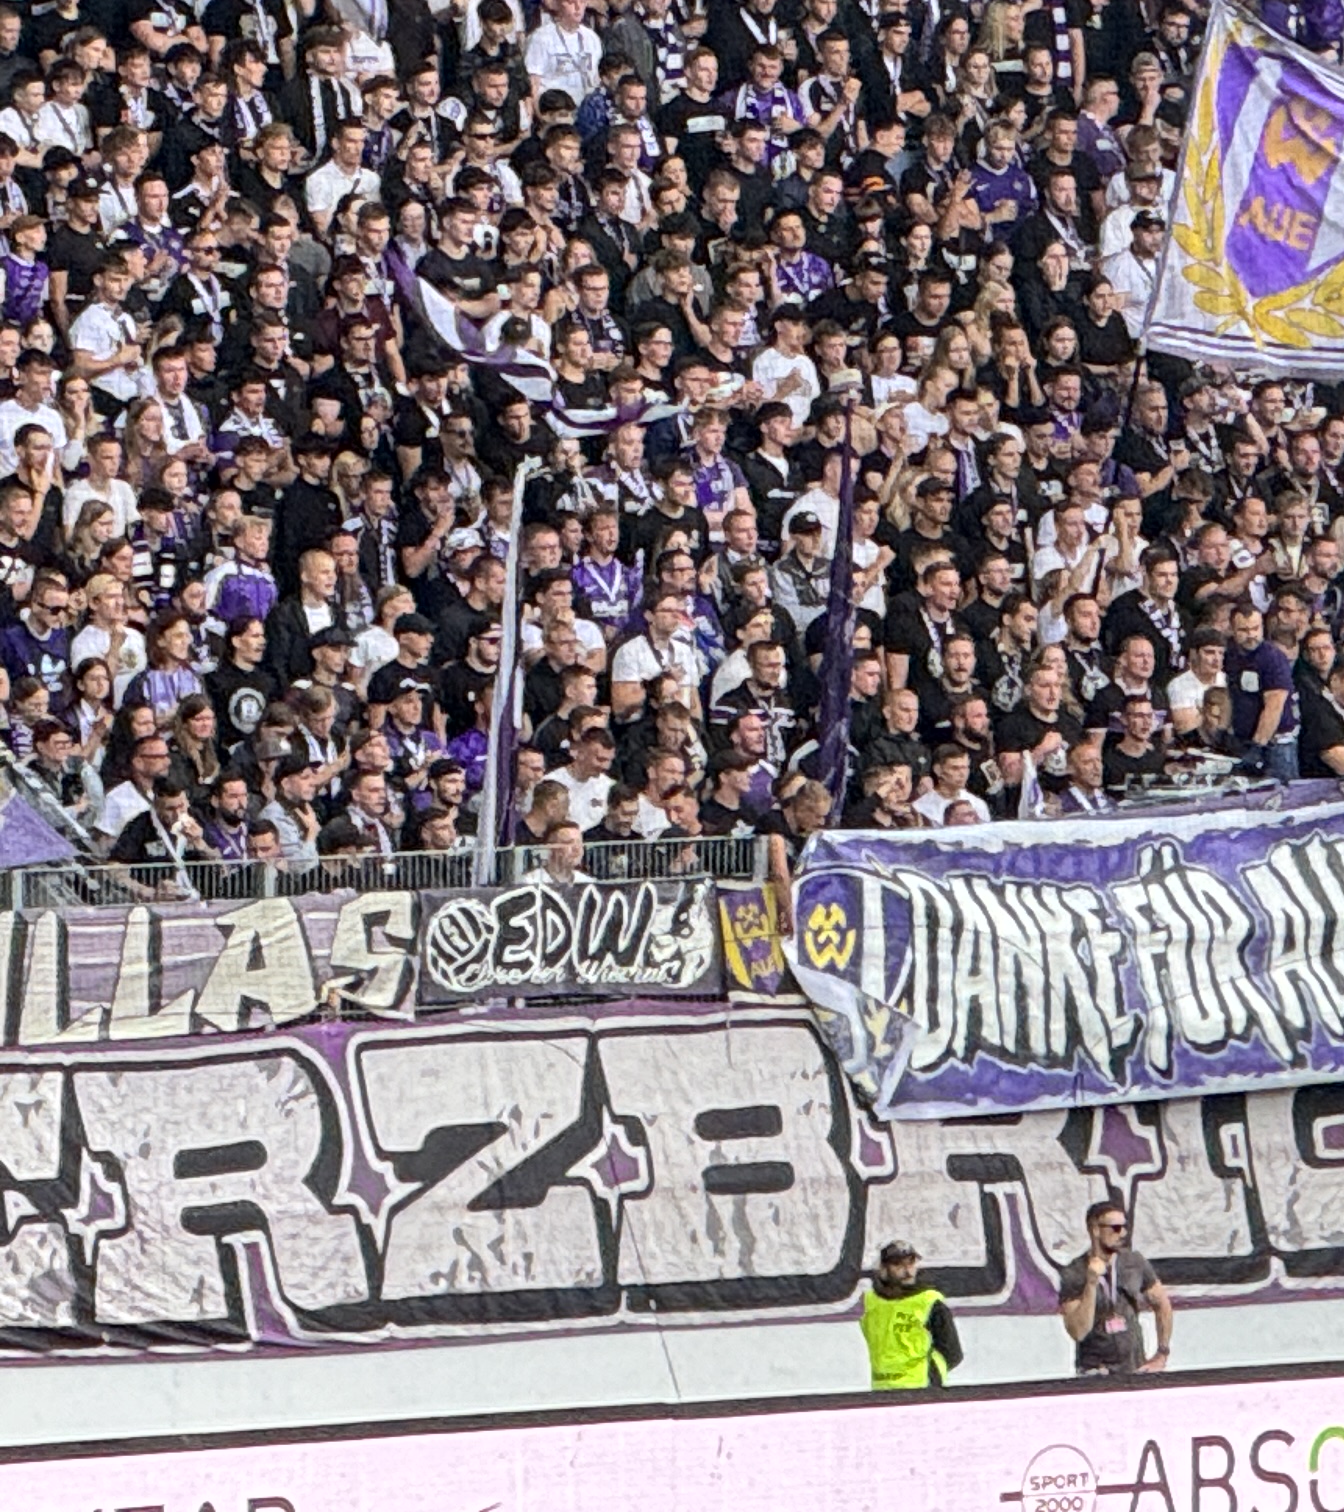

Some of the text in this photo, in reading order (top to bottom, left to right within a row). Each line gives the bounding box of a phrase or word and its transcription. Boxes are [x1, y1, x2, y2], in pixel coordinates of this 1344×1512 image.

[1237, 194, 1319, 252] AUE
[0, 890, 418, 1046] LLAS
[893, 866, 1141, 1084] DANKE
[1112, 841, 1294, 1073] FÜR
[1029, 1471, 1092, 1493] SPORT
